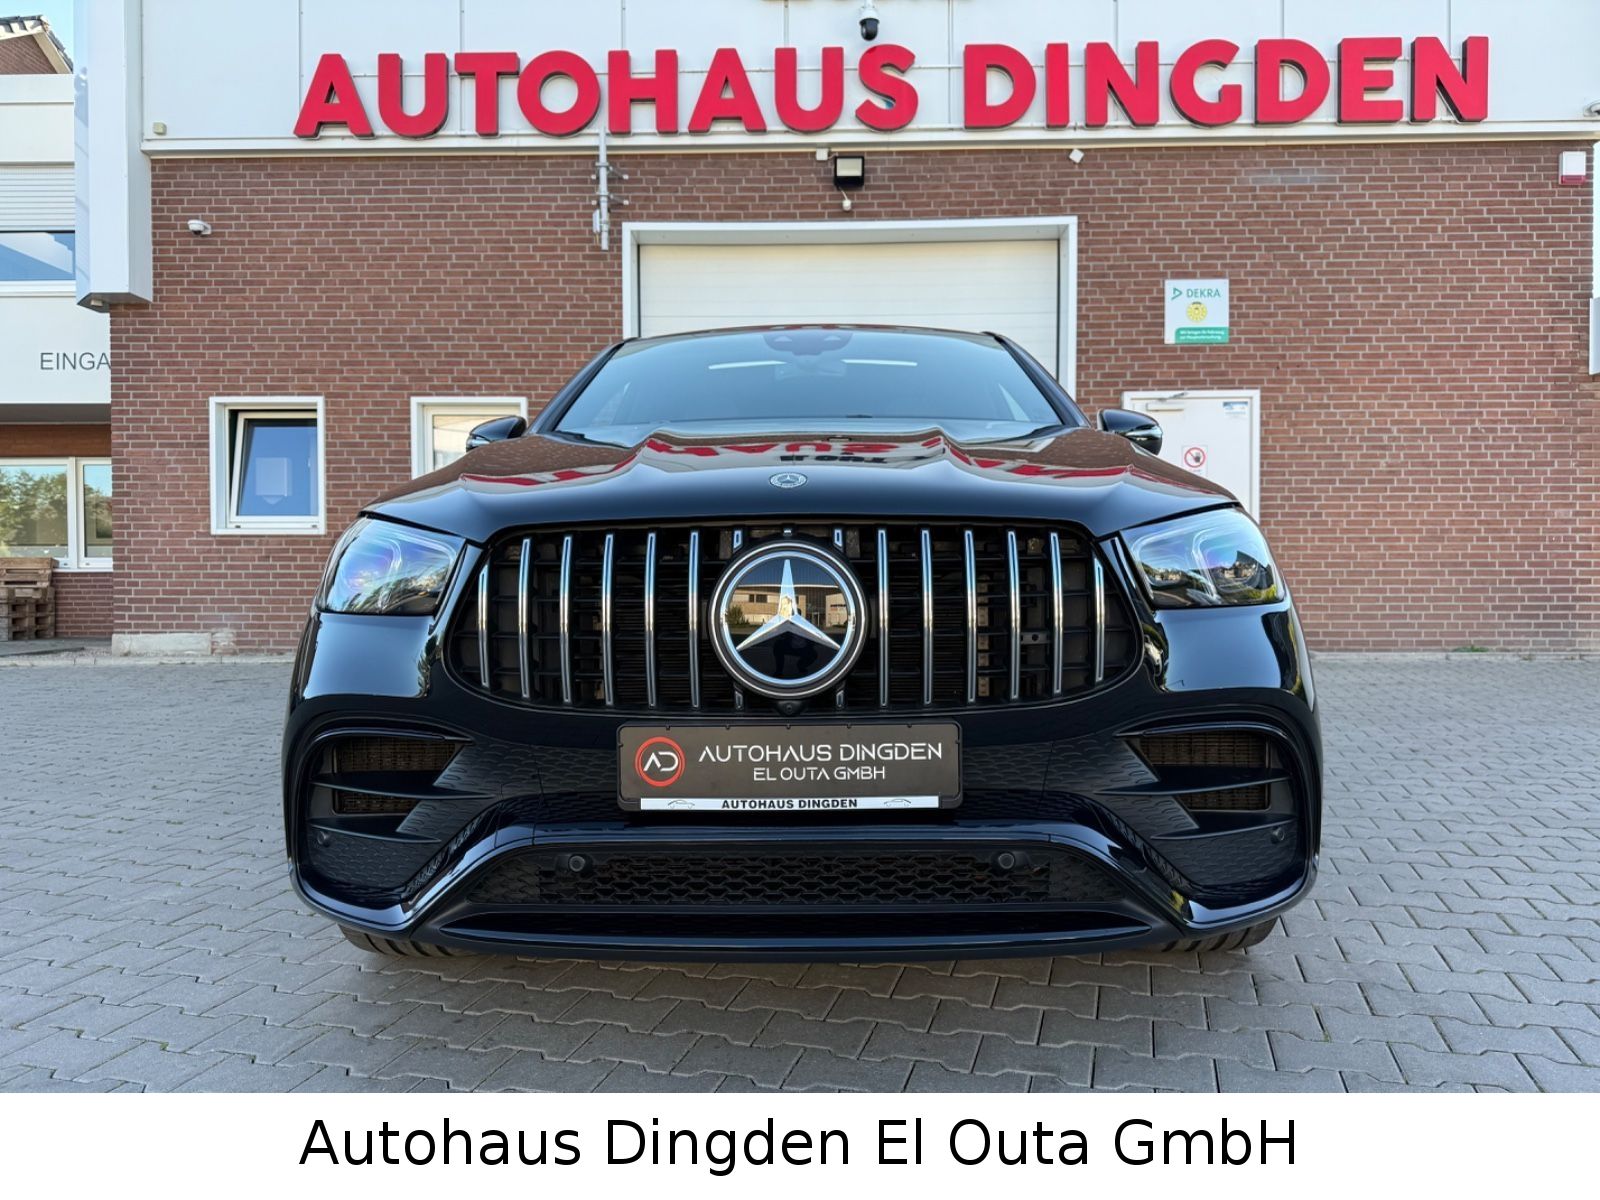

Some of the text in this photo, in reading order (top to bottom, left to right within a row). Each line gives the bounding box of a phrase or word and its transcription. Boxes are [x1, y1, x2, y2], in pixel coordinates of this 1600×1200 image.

[295, 36, 1490, 137] AUTOHAUS DINGDEN
[1186, 288, 1221, 298] DEKRA
[698, 742, 942, 763] AUTOHAUS DINGDEN
[753, 765, 886, 781] EL OUTA GMBH
[721, 798, 858, 809] AUTOHAUS DINGDEN
